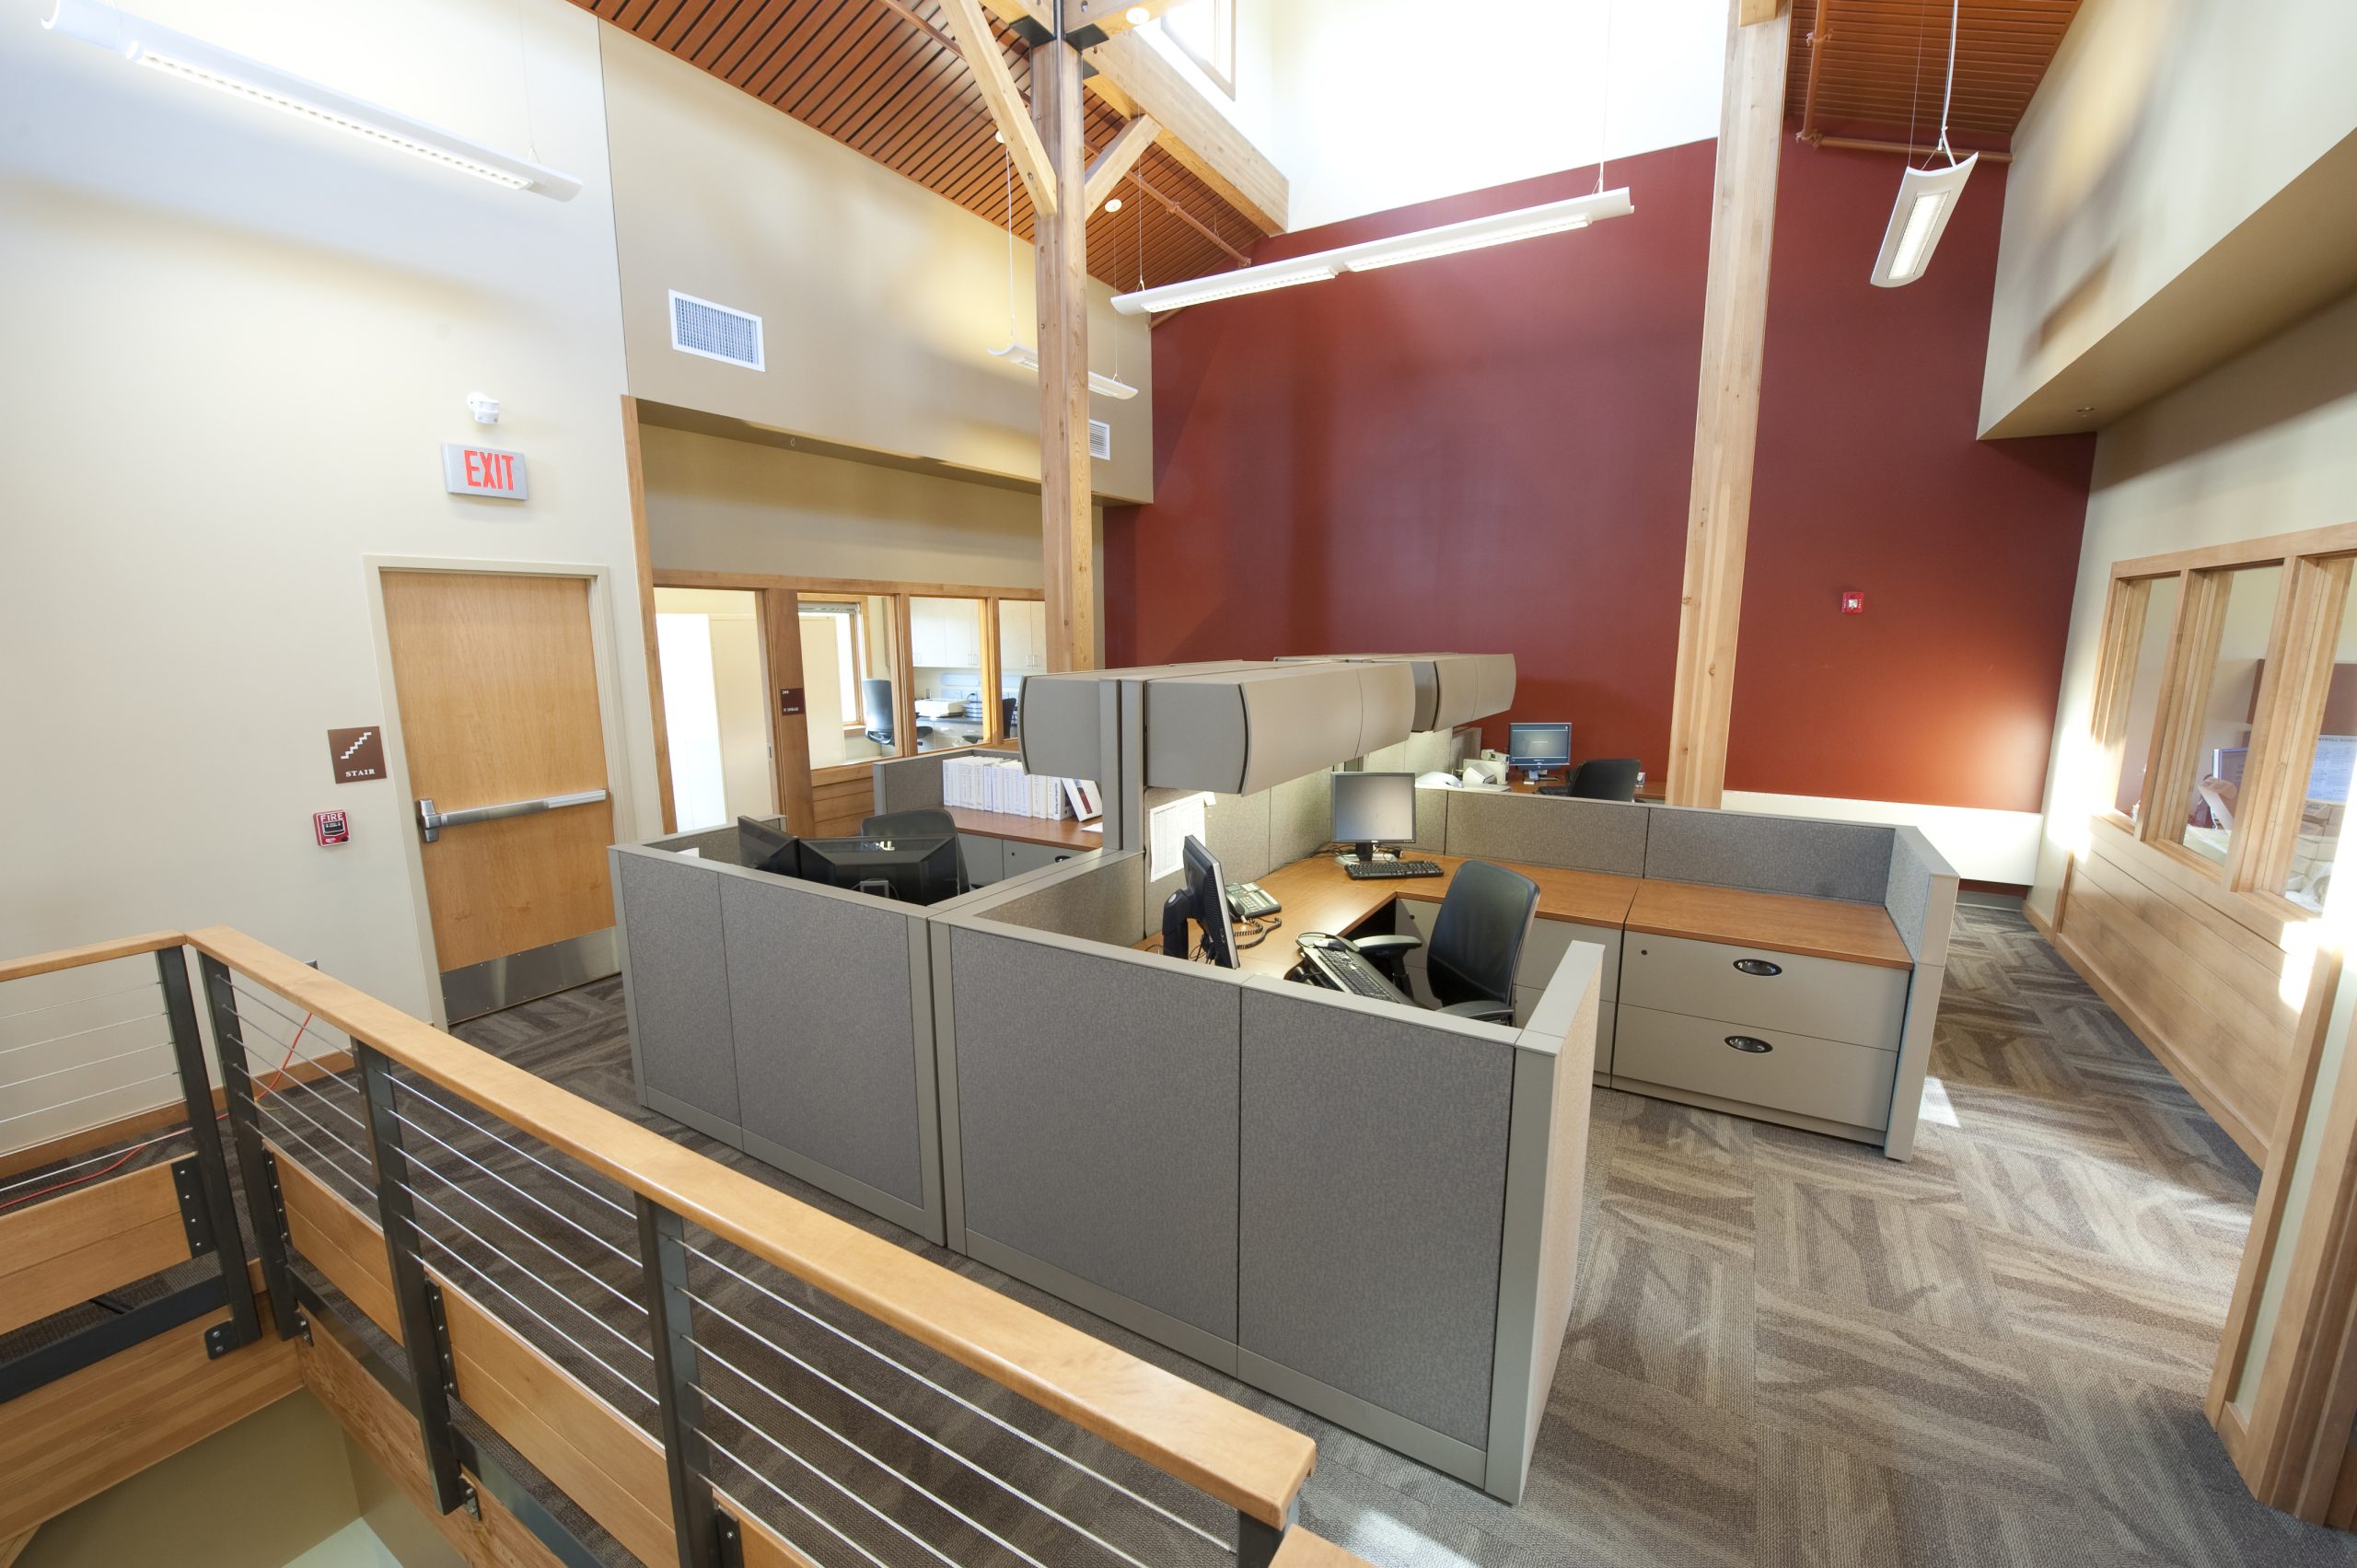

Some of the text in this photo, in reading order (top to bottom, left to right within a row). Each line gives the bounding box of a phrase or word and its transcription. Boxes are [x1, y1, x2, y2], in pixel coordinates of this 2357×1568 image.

[464, 450, 515, 491] EXIT
[345, 768, 376, 777] STAIR
[320, 812, 343, 821] FIRE
